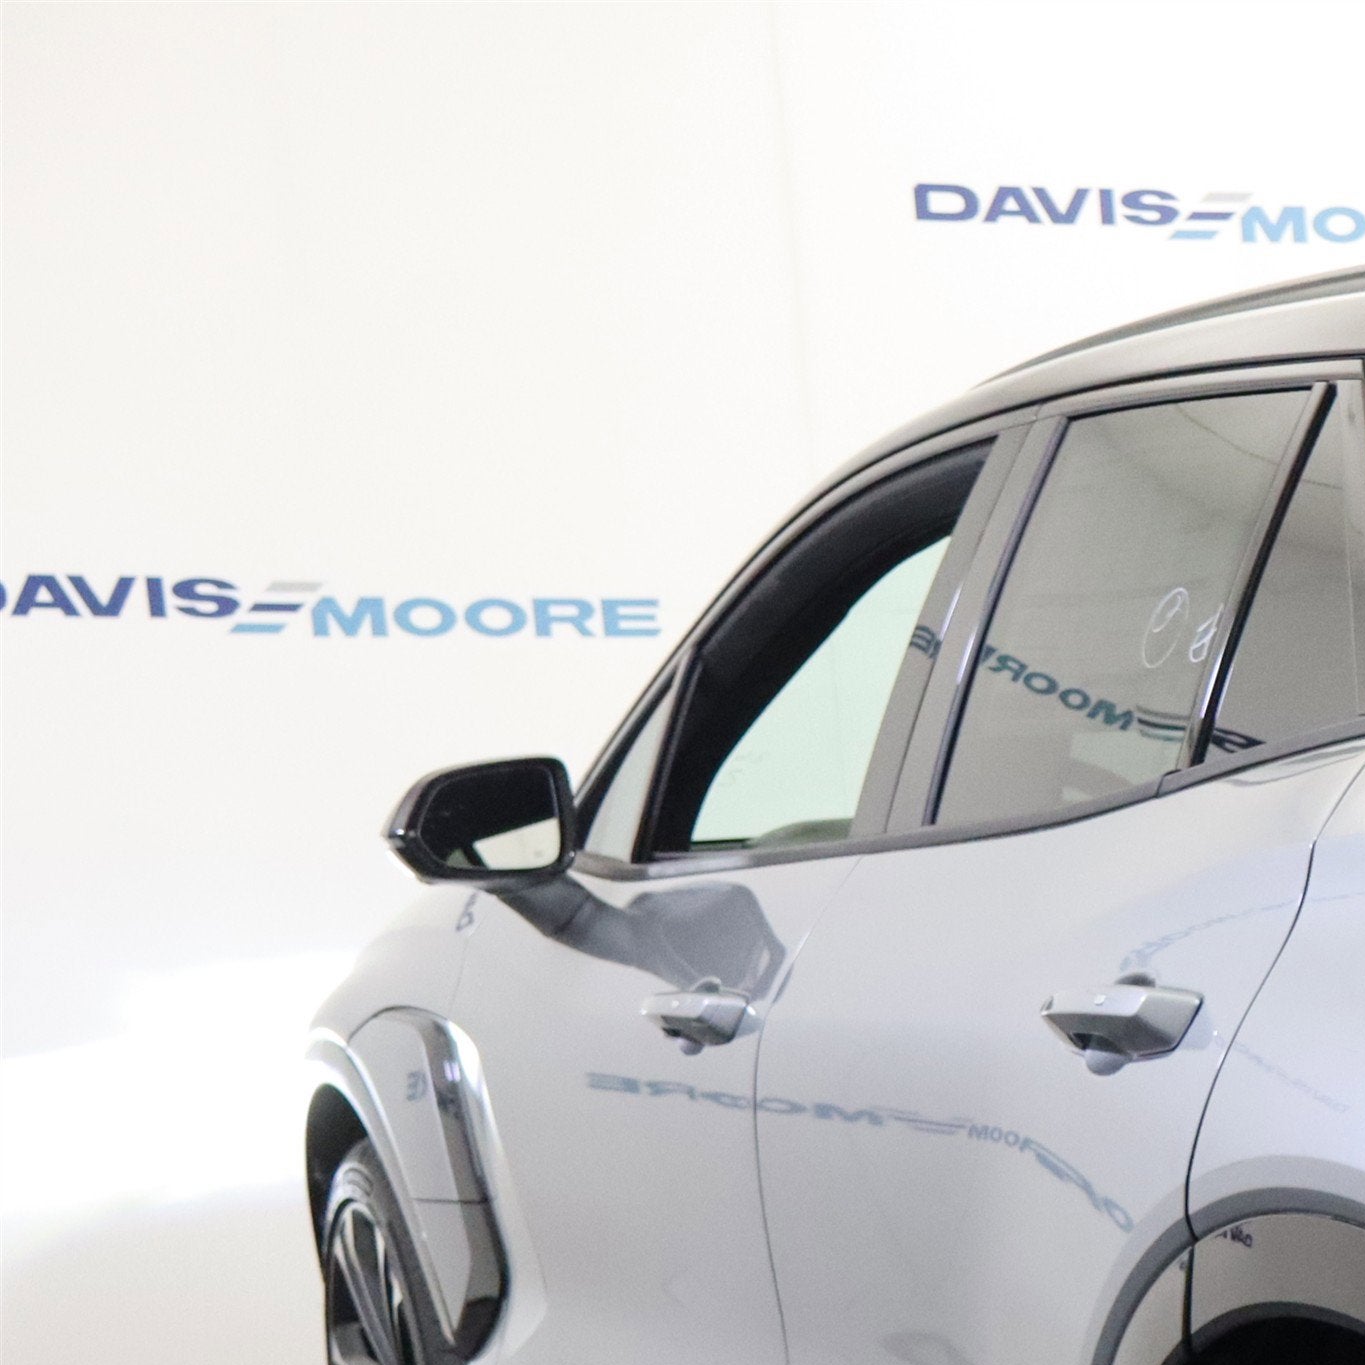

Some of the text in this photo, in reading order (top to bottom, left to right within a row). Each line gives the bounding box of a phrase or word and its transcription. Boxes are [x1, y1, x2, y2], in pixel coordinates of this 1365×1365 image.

[914, 183, 1179, 225] DAVIS
[0, 574, 661, 638] AVIS MOORE
